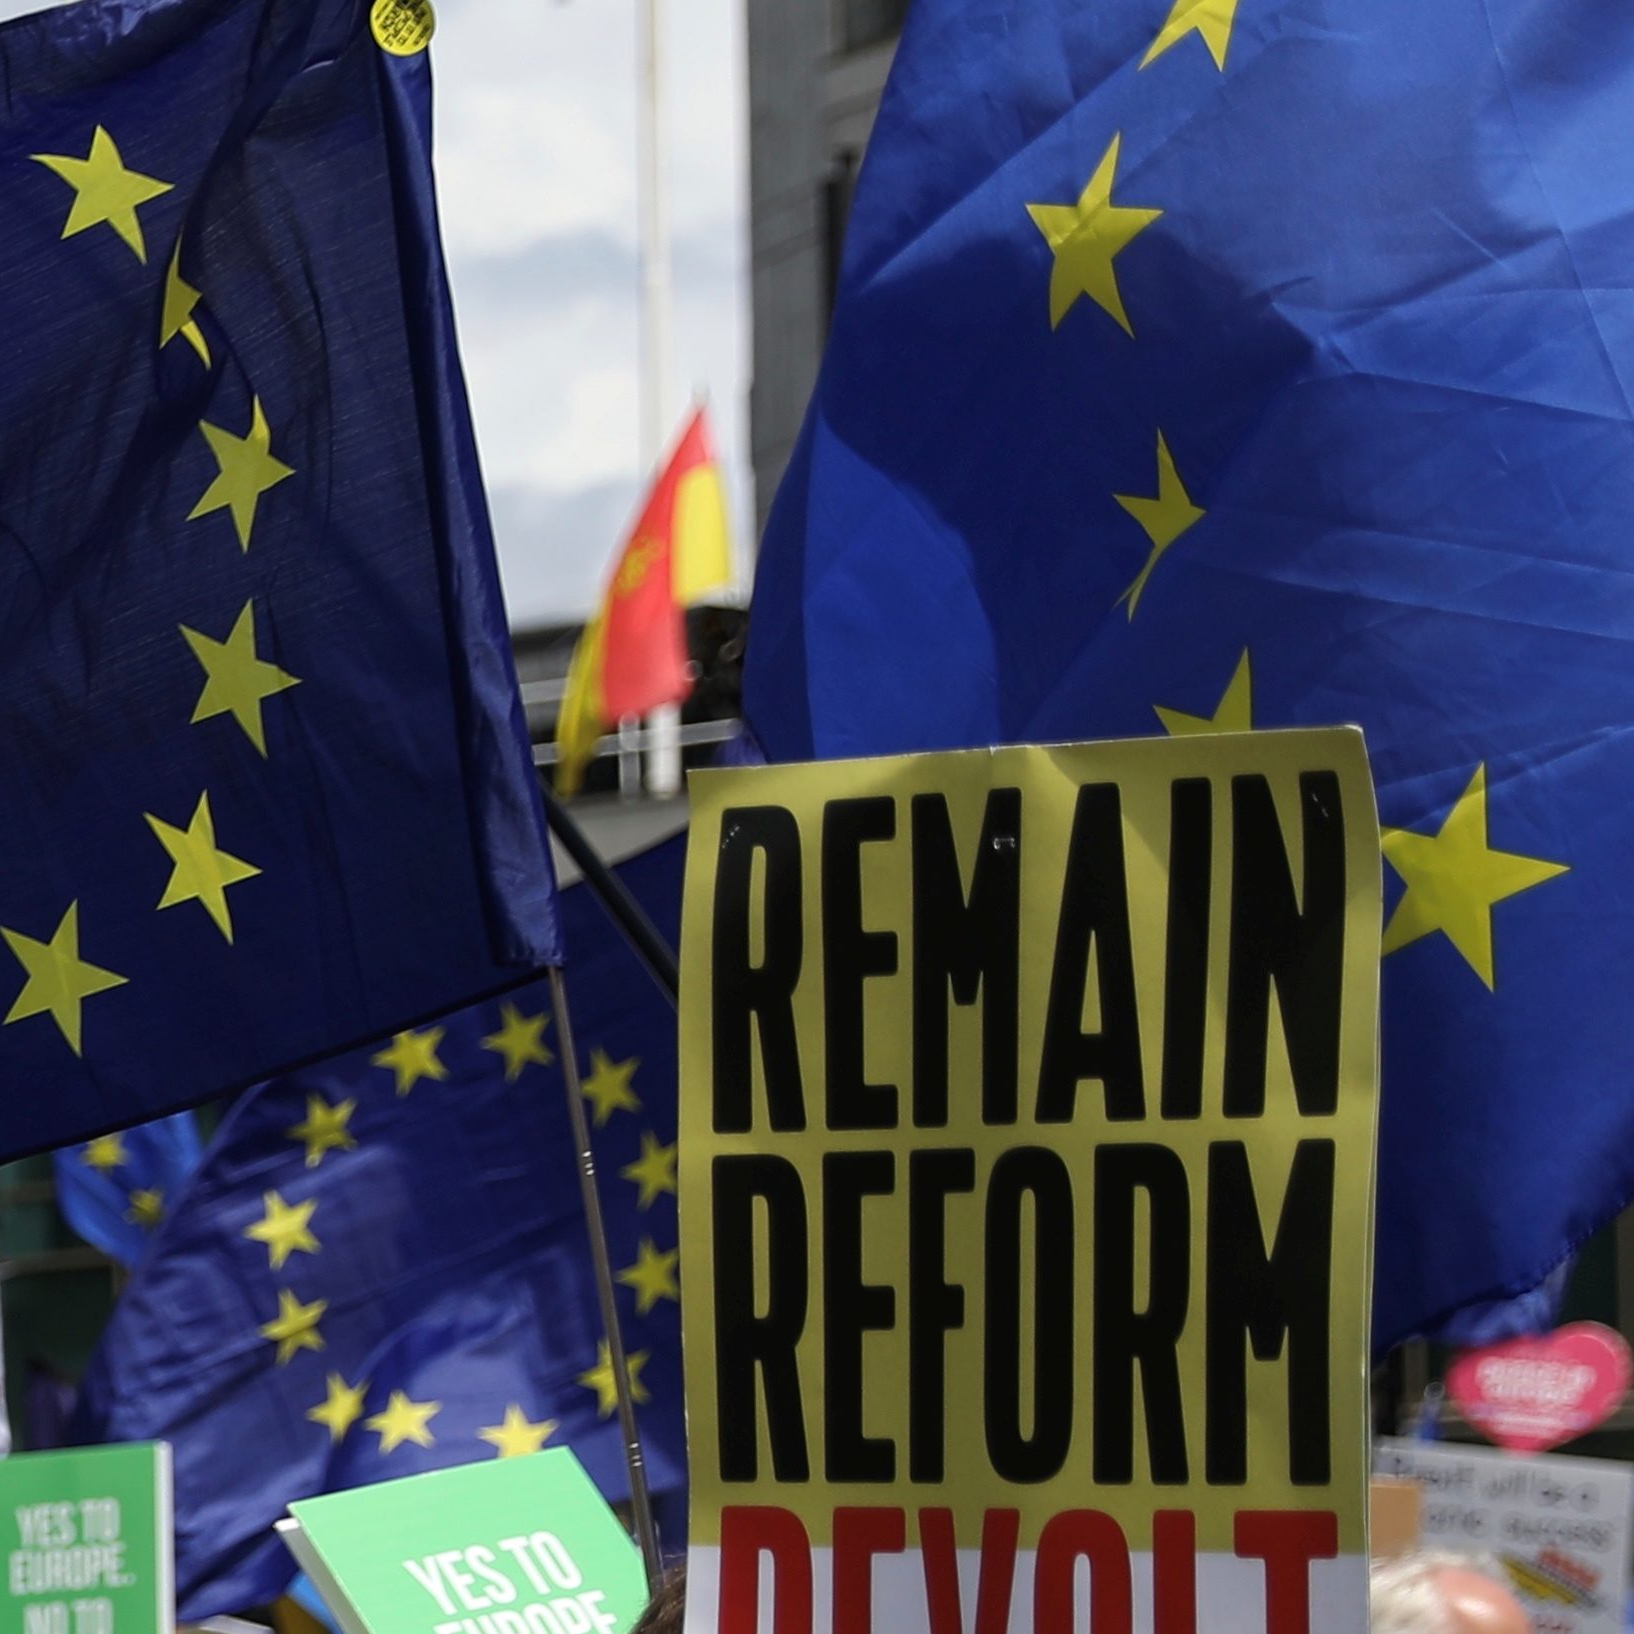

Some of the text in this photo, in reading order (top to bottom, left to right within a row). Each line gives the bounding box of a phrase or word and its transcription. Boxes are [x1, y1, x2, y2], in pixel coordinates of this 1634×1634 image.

[711, 770, 1346, 1135] REMAIN
[712, 1138, 1336, 1486] REFORM
[14, 1496, 121, 1548] YES TO
[401, 1530, 583, 1616] YES TO
